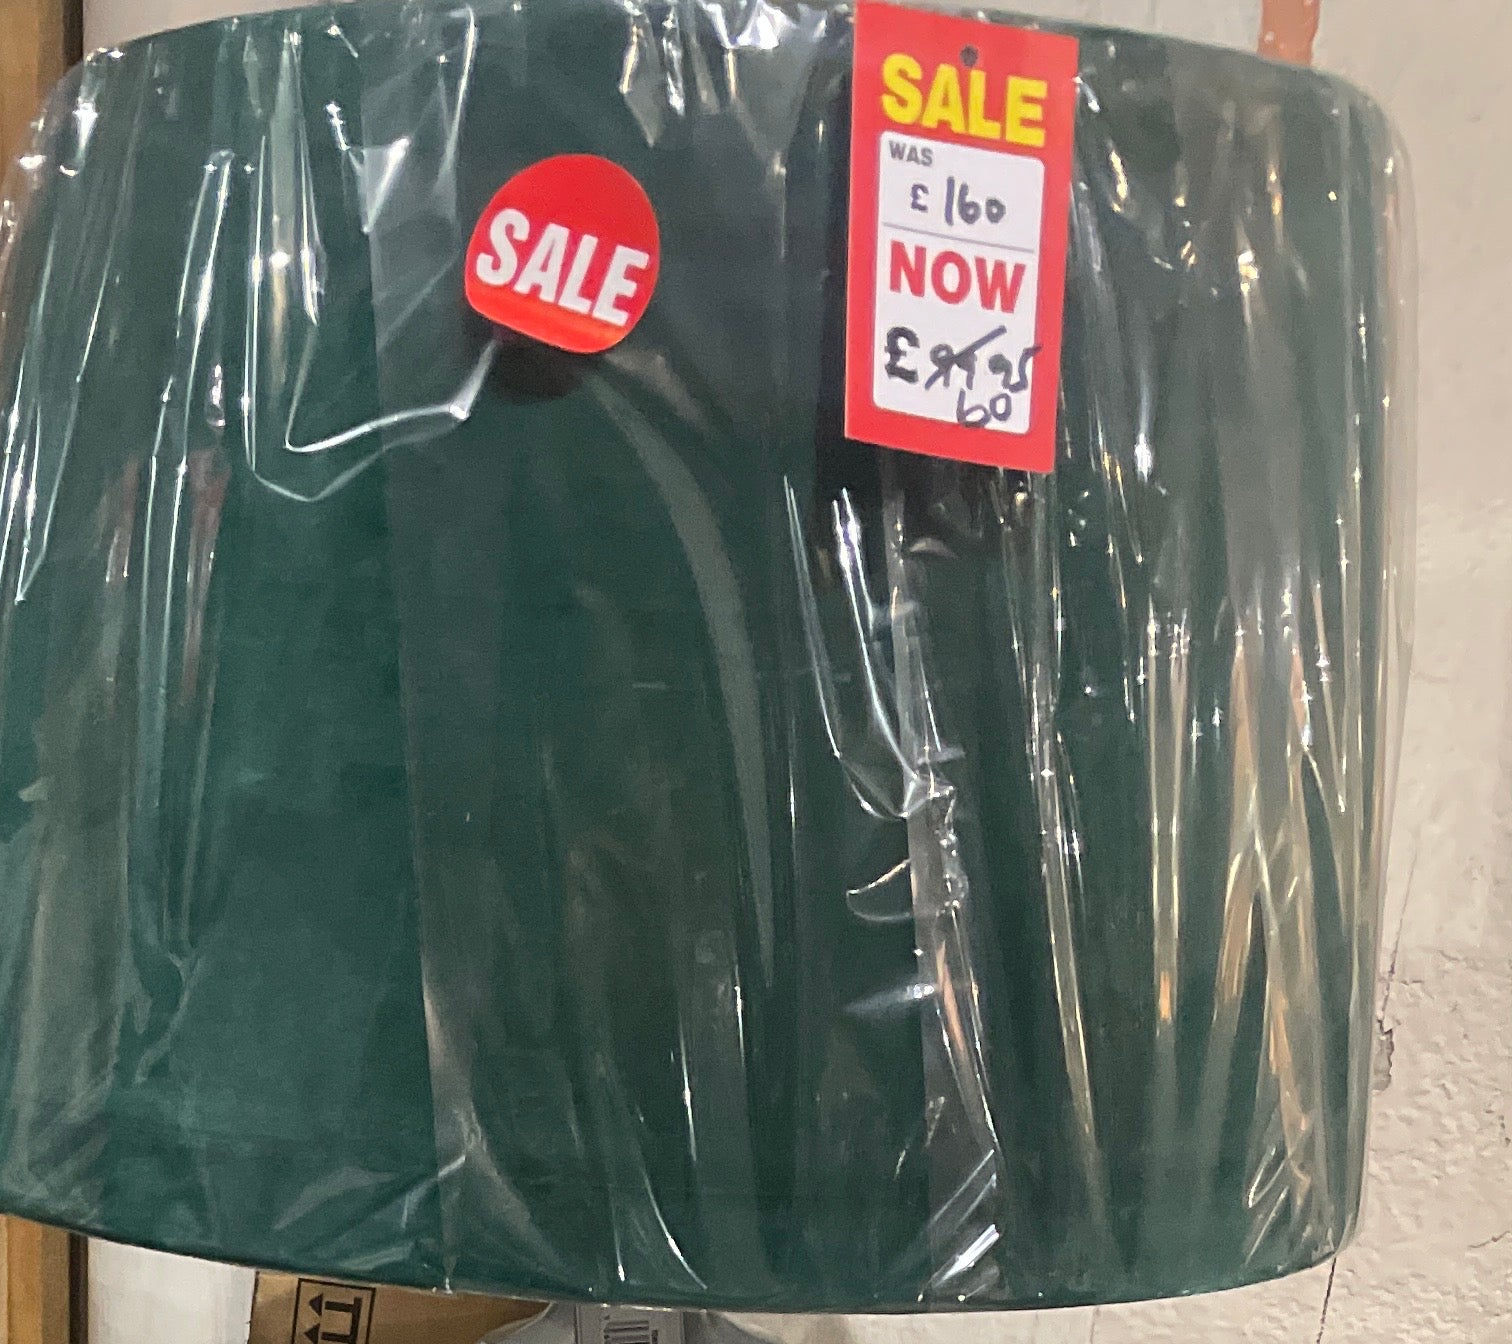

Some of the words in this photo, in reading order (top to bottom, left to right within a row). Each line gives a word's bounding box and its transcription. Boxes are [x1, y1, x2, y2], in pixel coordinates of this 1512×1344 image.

[881, 53, 1048, 147] SALE
[889, 140, 934, 168] WAS
[476, 208, 650, 327] SALE
[889, 241, 1026, 314] NOW
[956, 388, 1012, 428] 60
